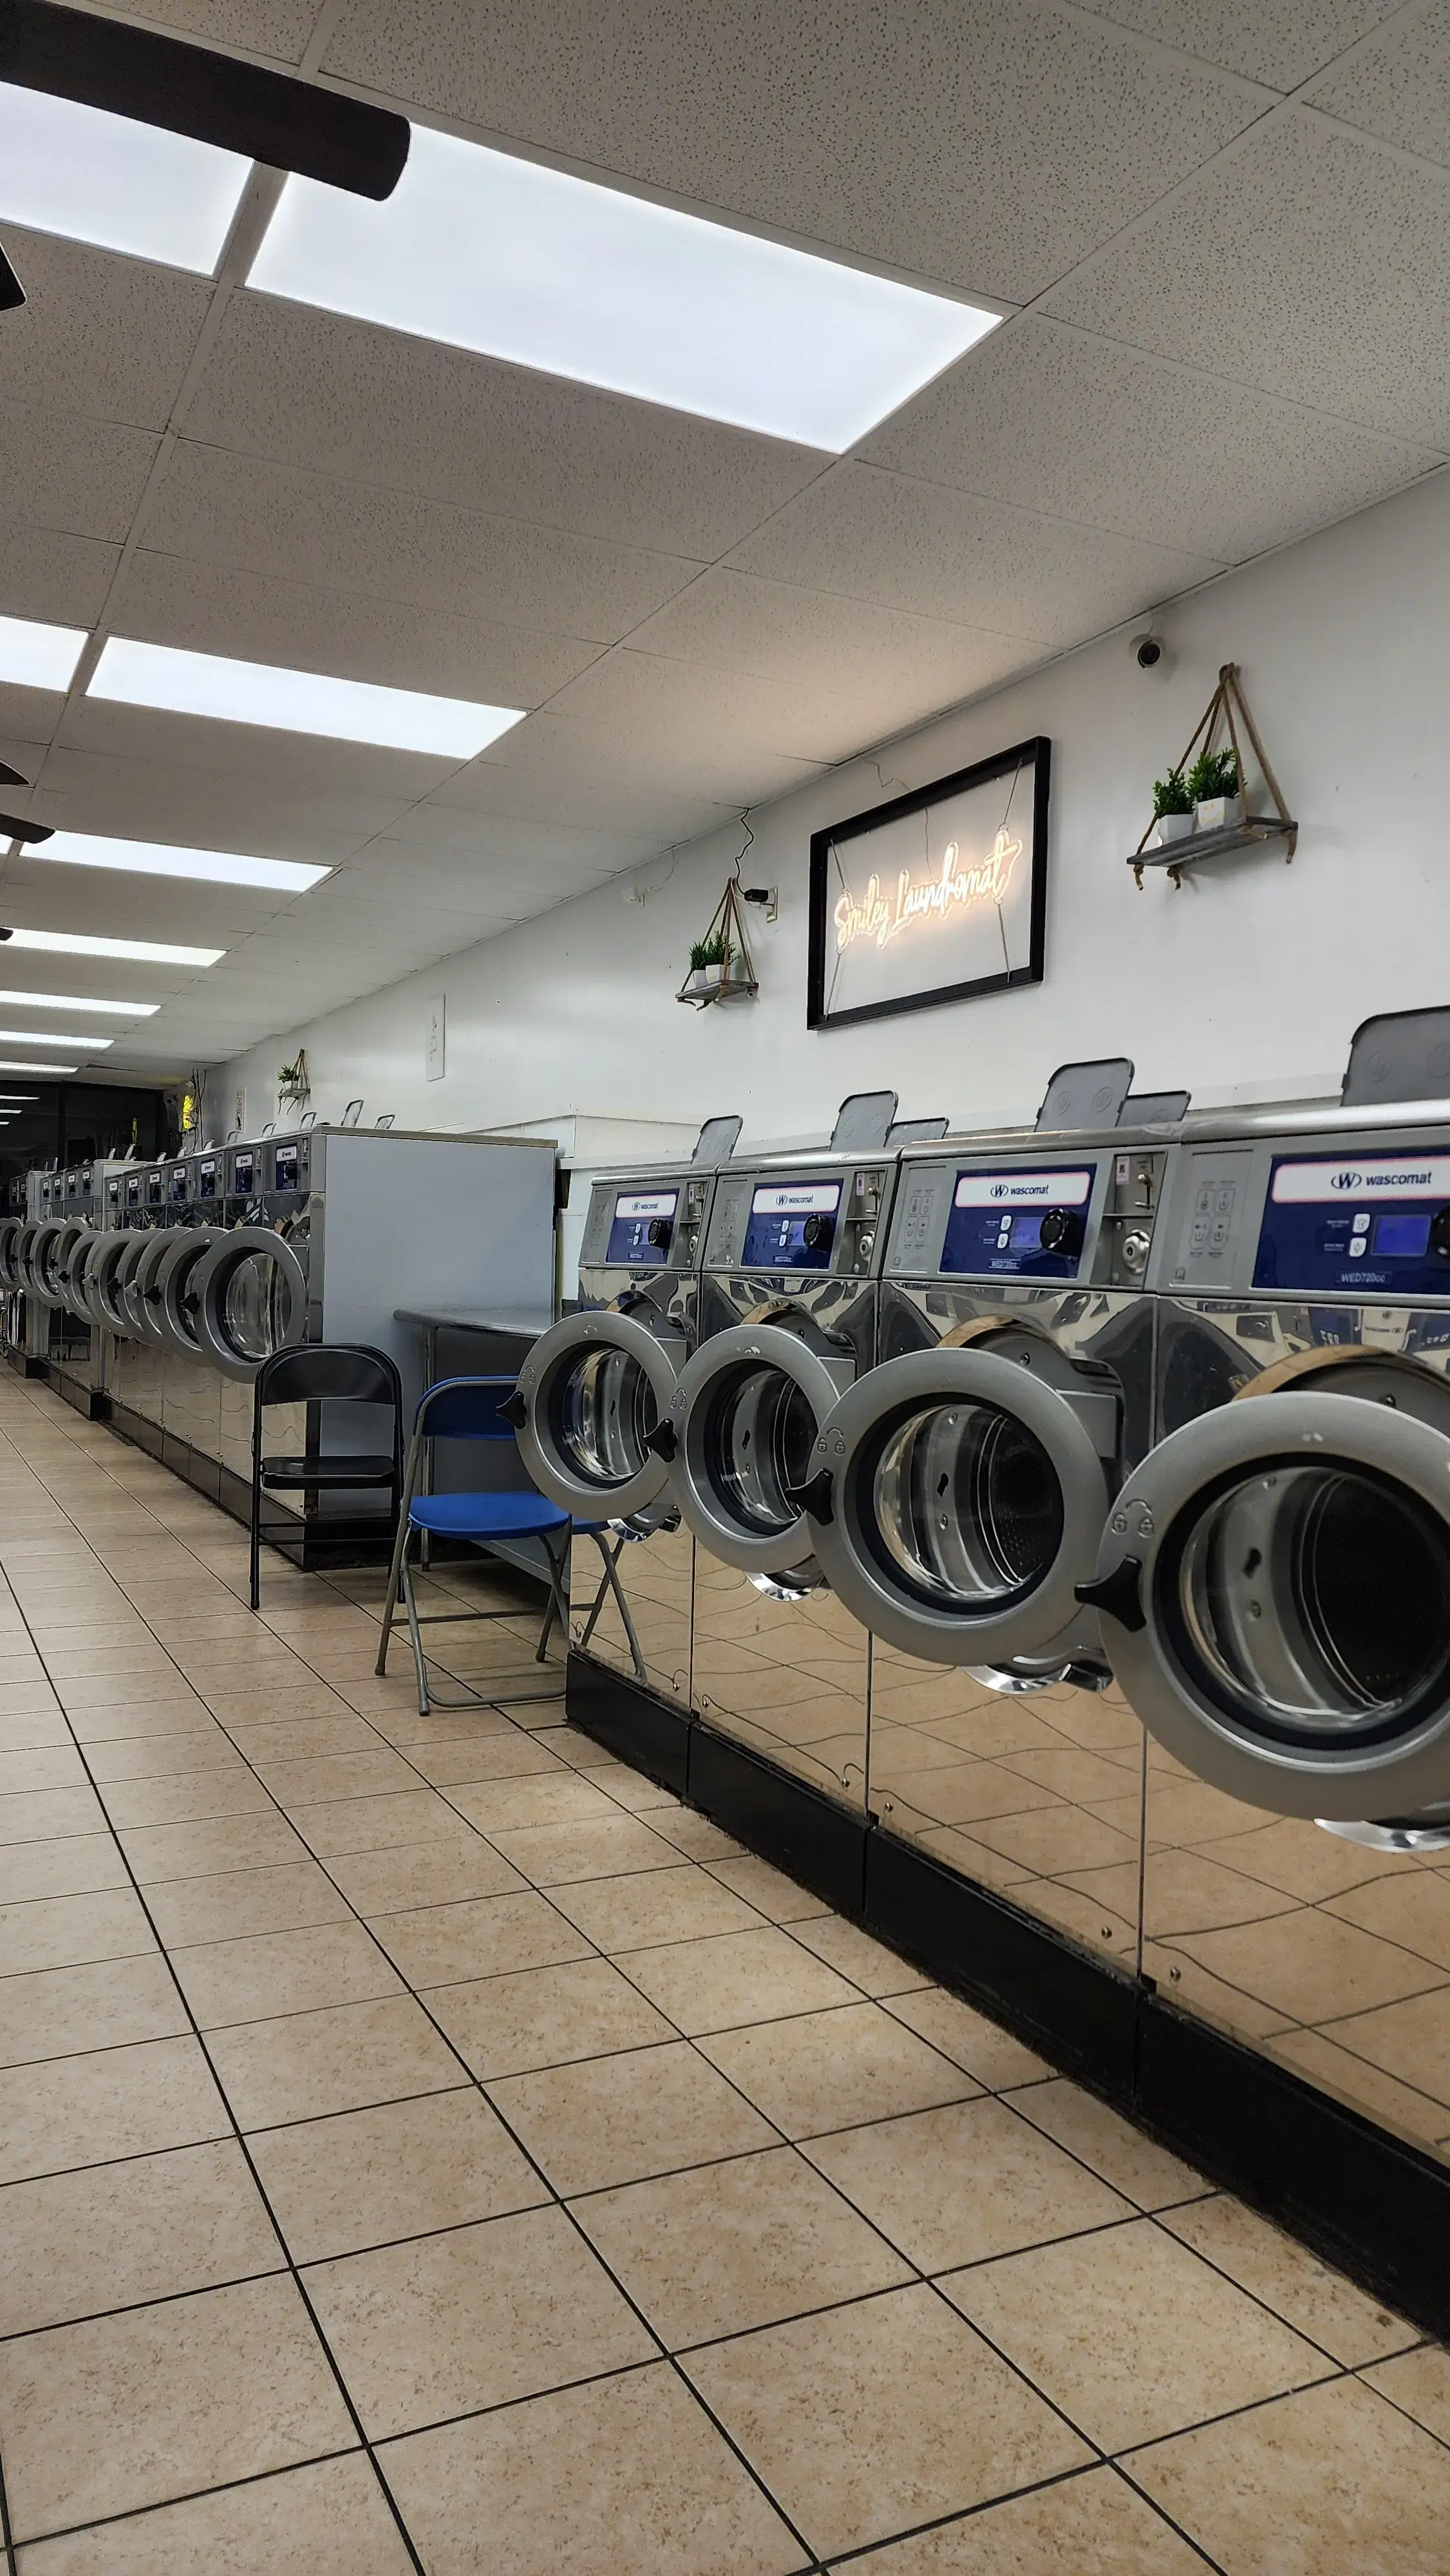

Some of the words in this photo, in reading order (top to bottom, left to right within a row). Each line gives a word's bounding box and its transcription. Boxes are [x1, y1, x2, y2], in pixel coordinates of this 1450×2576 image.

[835, 874, 890, 948] Smiley
[892, 831, 1020, 931] Laundromat
[1366, 1171, 1432, 1186] wascomat
[1011, 1184, 1049, 1195] wascomat
[789, 1195, 813, 1204] wascomat
